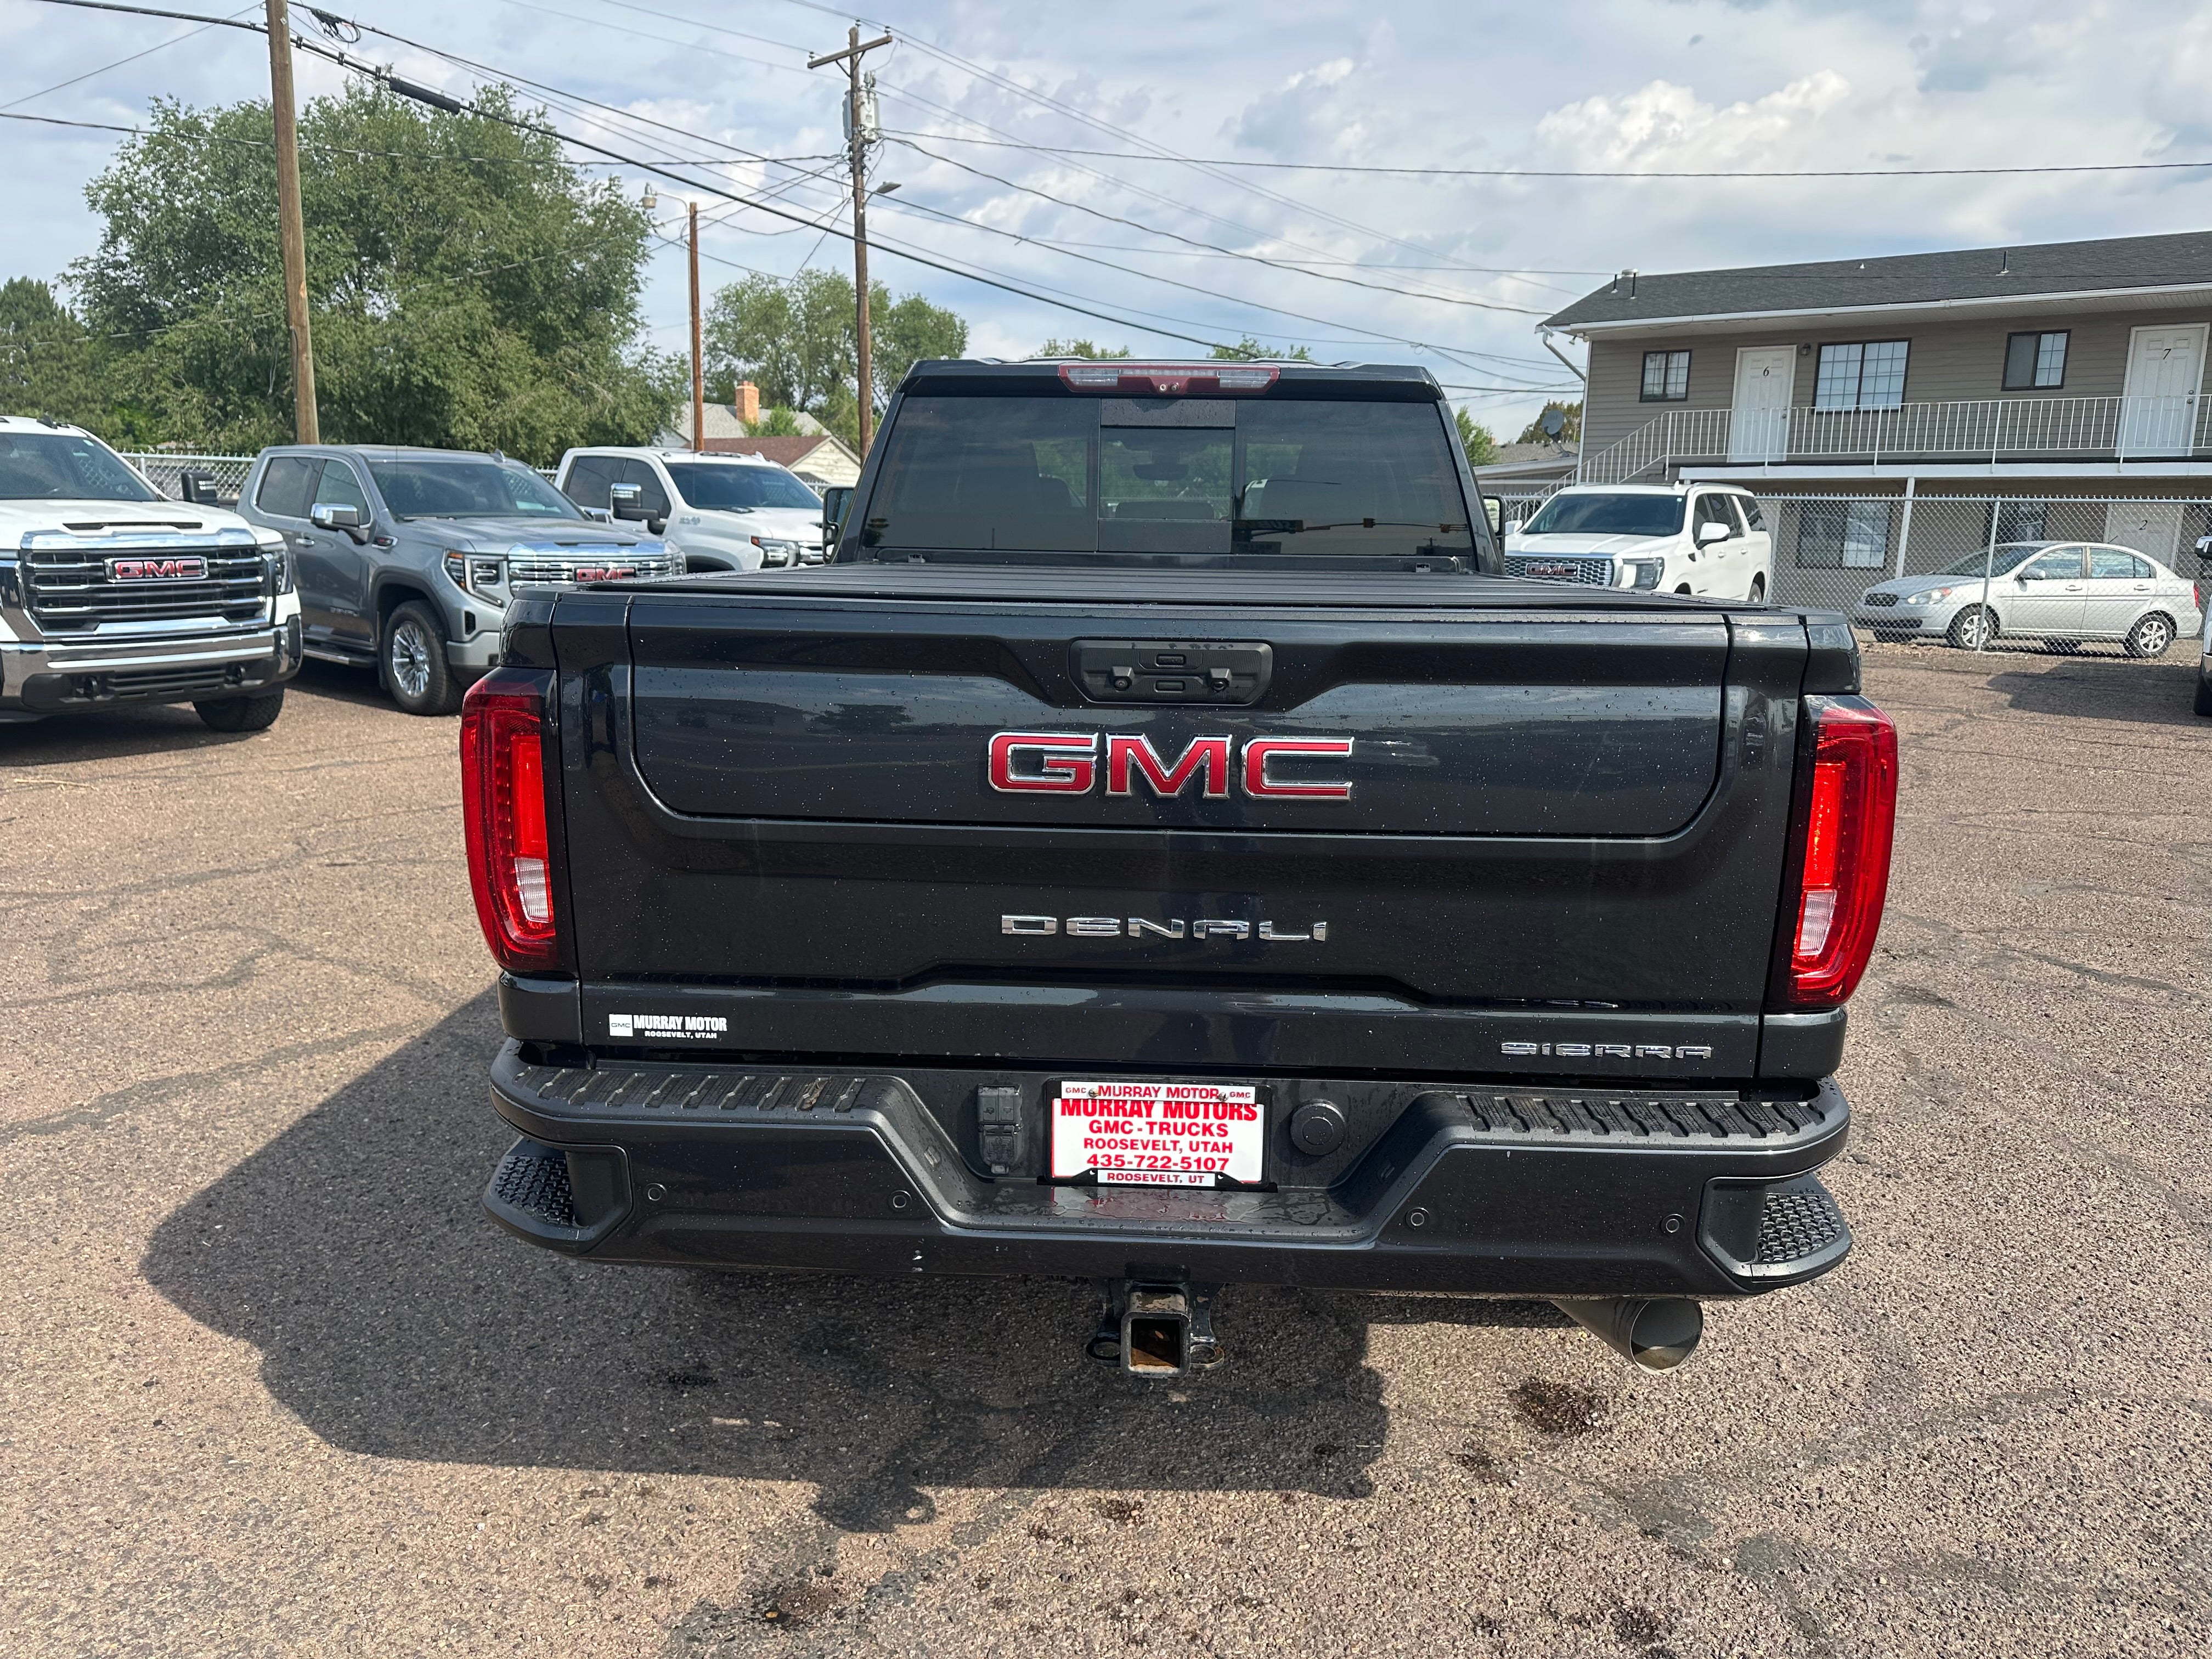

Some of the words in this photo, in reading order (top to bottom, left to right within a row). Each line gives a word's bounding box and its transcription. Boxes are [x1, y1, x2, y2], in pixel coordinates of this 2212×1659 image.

[2163, 348, 2171, 359] 7
[1763, 365, 1769, 377] 6
[2138, 520, 2147, 530] 2
[115, 560, 202, 579] GMC
[577, 568, 635, 582] GMC
[1527, 565, 1577, 575] GMC
[988, 732, 1355, 801] GMC
[1001, 915, 1328, 941] DENALI
[633, 1015, 683, 1030] MURRAY
[685, 1016, 727, 1031] MOTOR
[645, 1030, 693, 1039] ROOSEVELT,
[1501, 1042, 1712, 1059] SIERRA
[1098, 1085, 1161, 1098] MURRAY
[1167, 1087, 1219, 1099] MOTOR
[1061, 1099, 1154, 1118] MURRAY
[1163, 1101, 1257, 1121] MOTORS
[1084, 1138, 1183, 1154] ROOSEVELT,
[1189, 1141, 1233, 1153] UTAH
[1086, 1154, 1229, 1171] 435-722-5107
[1107, 1173, 1183, 1183] ROOSEVELT,
[1188, 1175, 1205, 1183] UT
